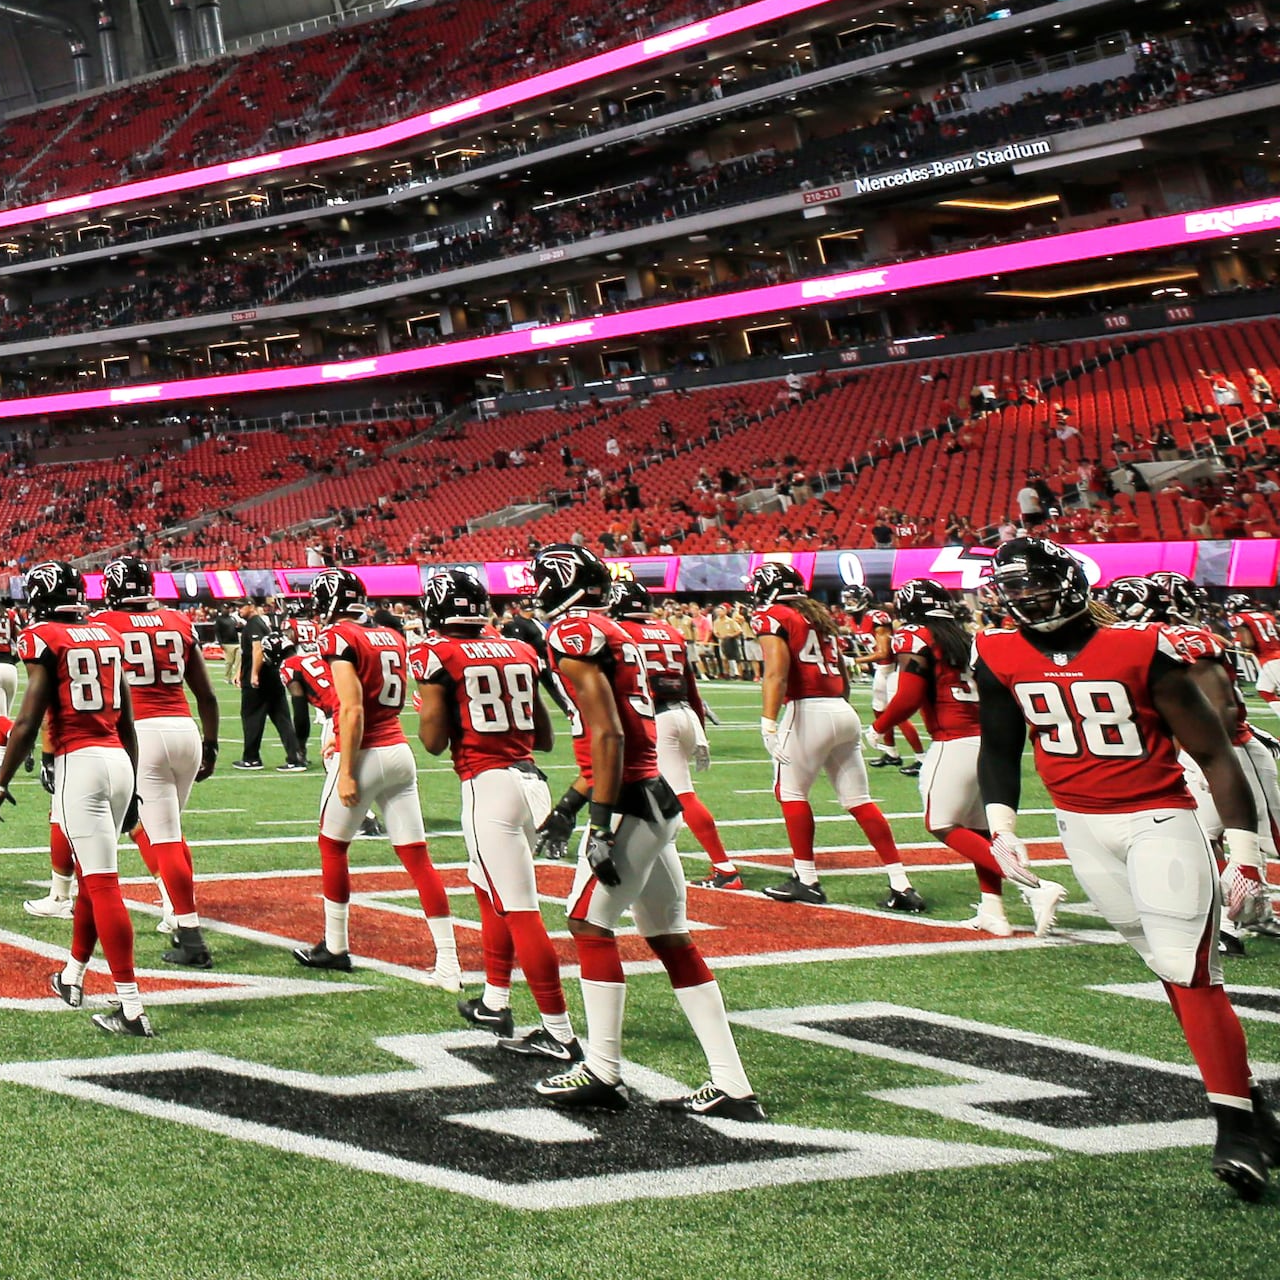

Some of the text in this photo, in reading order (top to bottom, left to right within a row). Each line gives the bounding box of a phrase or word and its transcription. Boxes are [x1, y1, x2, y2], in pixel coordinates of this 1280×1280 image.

[854, 141, 1051, 193] Mercedes-Benz Stadium
[804, 188, 839, 203] 210-211
[1106, 314, 1127, 328] 110
[1167, 307, 1189, 320] 111
[838, 552, 863, 586] 0
[130, 615, 164, 628] ODOM
[66, 628, 112, 642] BURTON
[297, 625, 317, 642] 97
[364, 631, 399, 646] MEYER
[642, 627, 671, 641] JONES
[121, 631, 185, 686] 93
[461, 642, 517, 659] CHERRY
[66, 646, 122, 711] 87
[379, 650, 403, 707] 6
[1042, 670, 1085, 679] FALCONS
[463, 663, 535, 732] 88
[1014, 680, 1143, 757] 98
